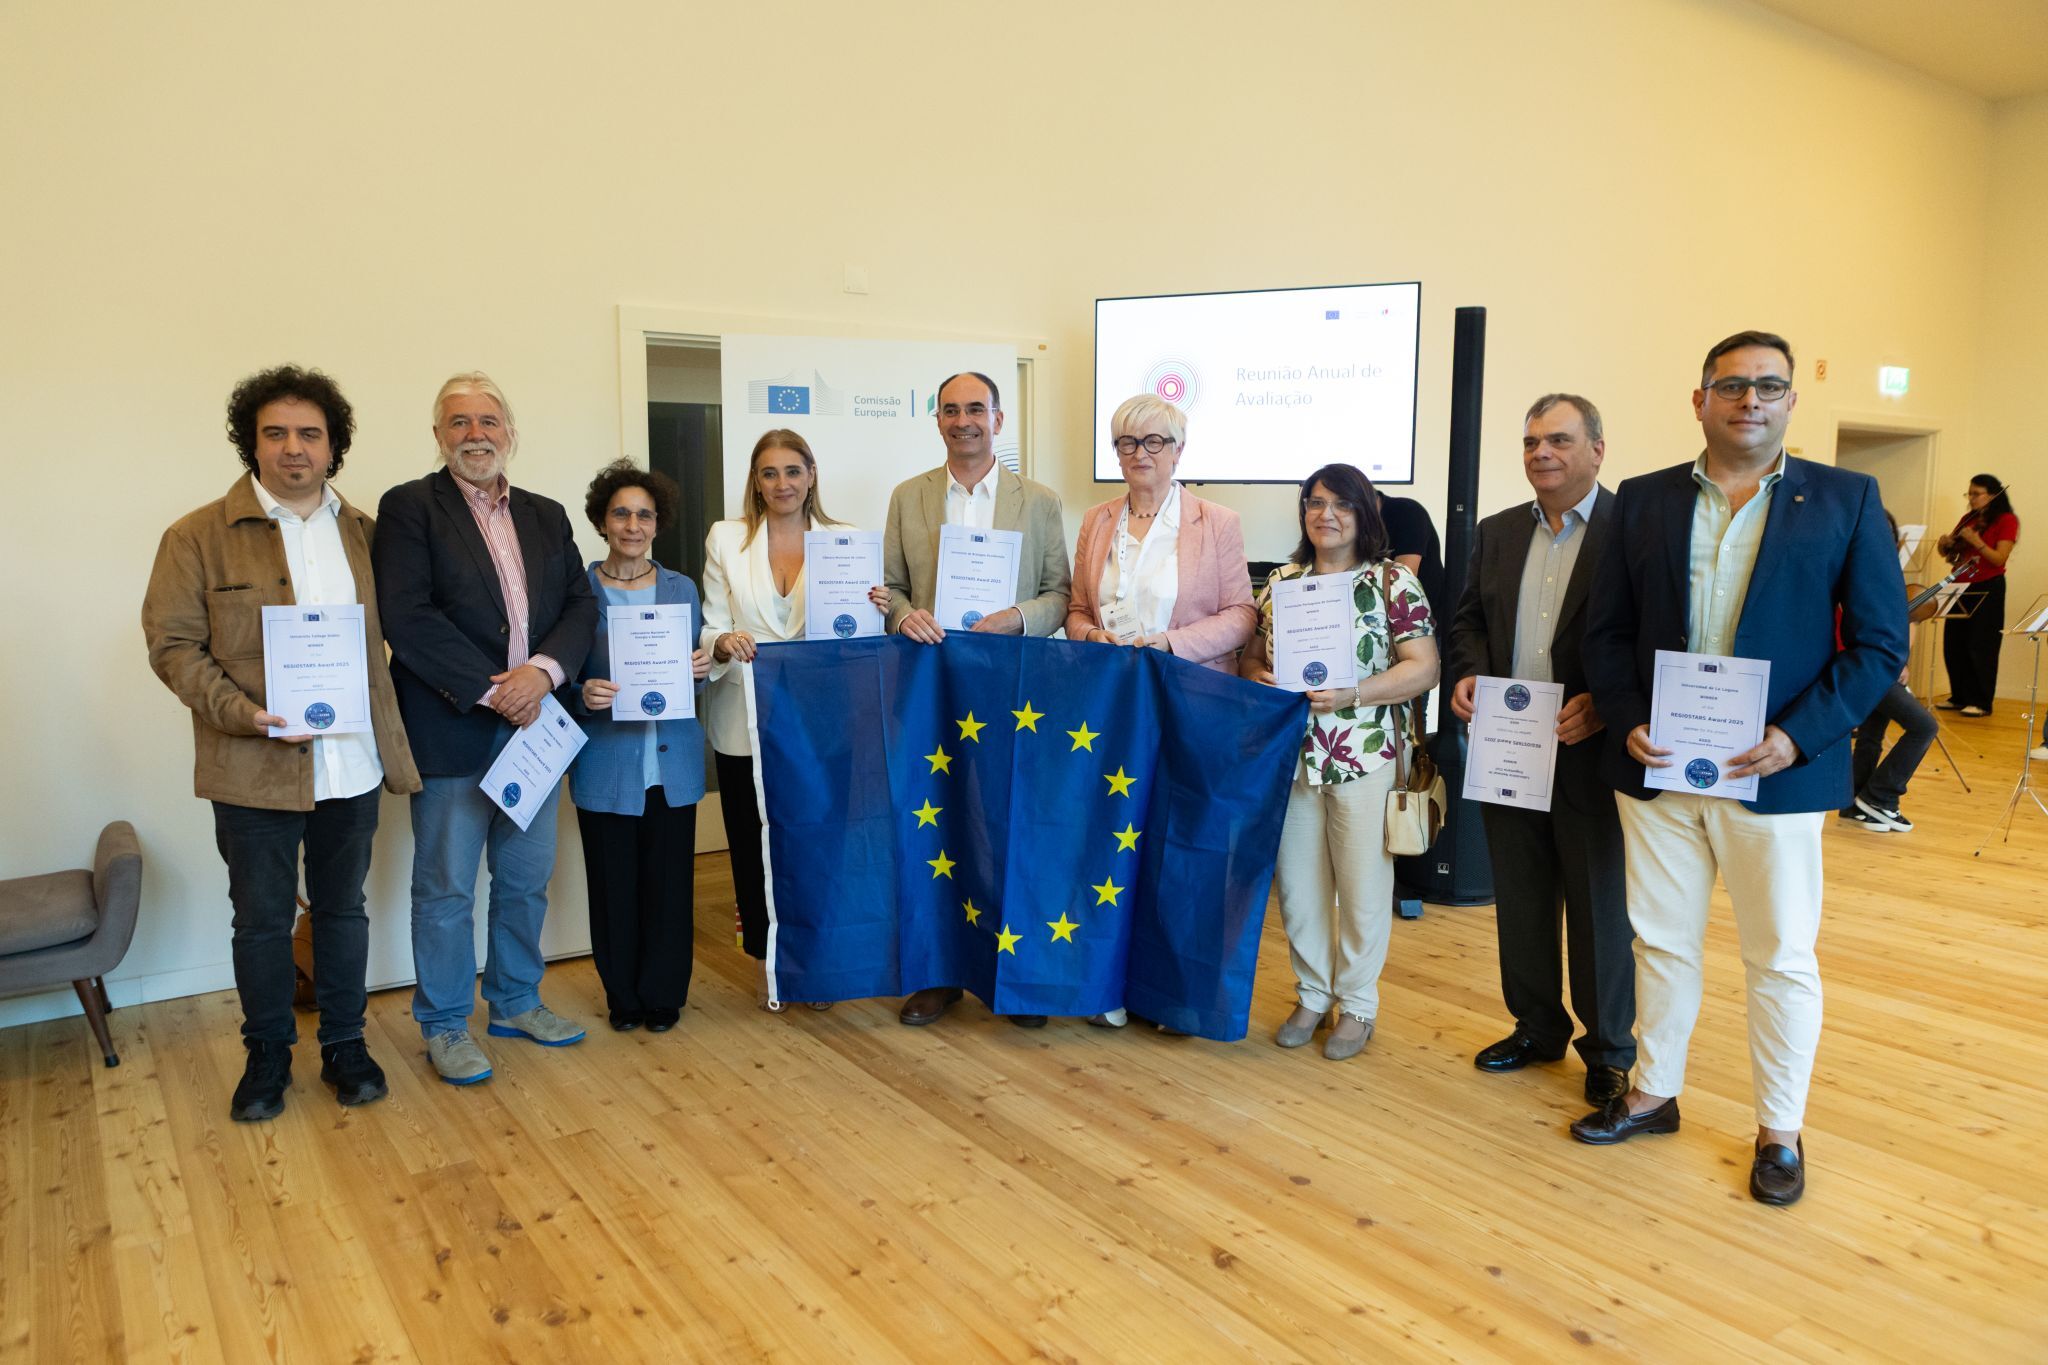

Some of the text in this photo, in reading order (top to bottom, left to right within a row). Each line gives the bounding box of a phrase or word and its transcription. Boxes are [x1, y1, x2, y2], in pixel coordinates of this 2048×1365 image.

[1236, 363, 1383, 381] Reunião Anual de
[854, 396, 901, 406] Comissão
[1235, 391, 1313, 409] Avaliação
[854, 408, 897, 418] Europeia
[1671, 712, 1706, 721] REGIOSTARS
[1708, 715, 1727, 723] Award
